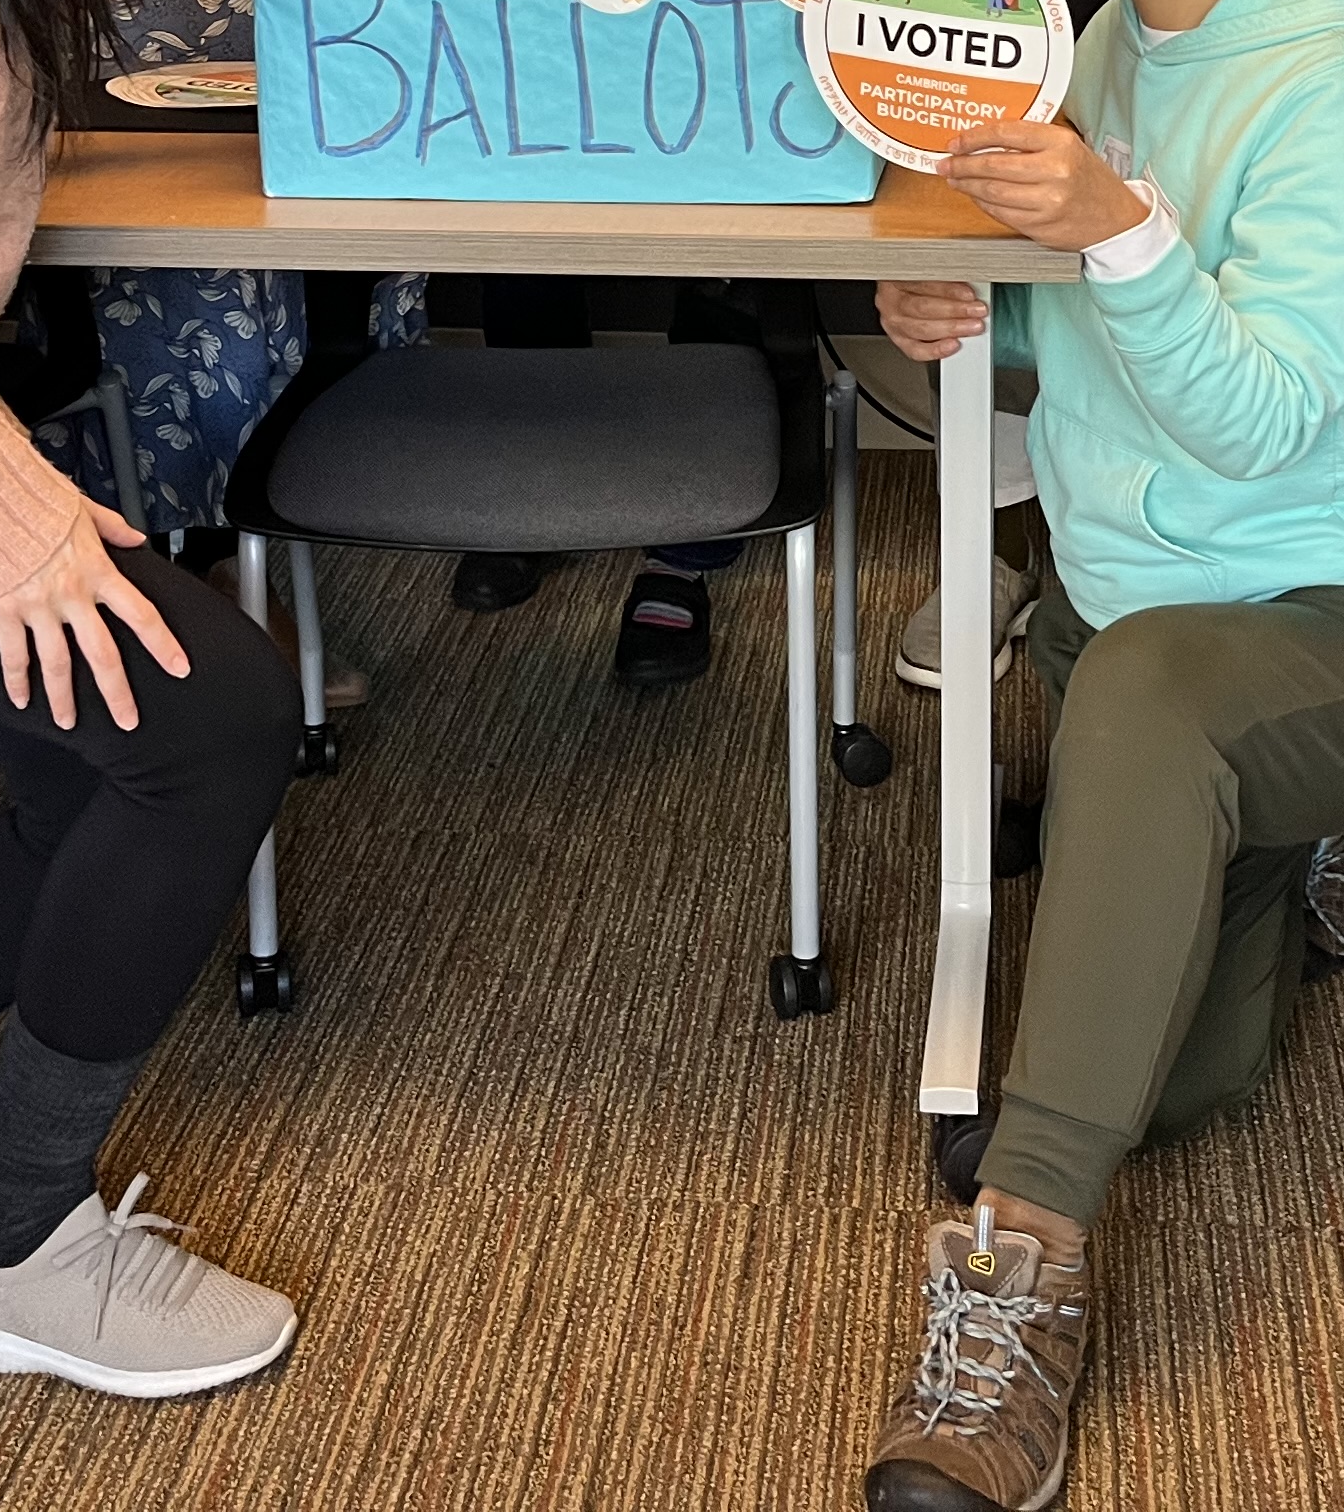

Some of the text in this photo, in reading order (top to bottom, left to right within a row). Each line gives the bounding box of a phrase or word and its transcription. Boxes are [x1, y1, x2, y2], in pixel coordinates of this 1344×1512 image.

[856, 13, 1023, 70] I VOTED
[859, 81, 1007, 120] PARTICIPATORY
[896, 73, 968, 95] CAMBRIDGE
